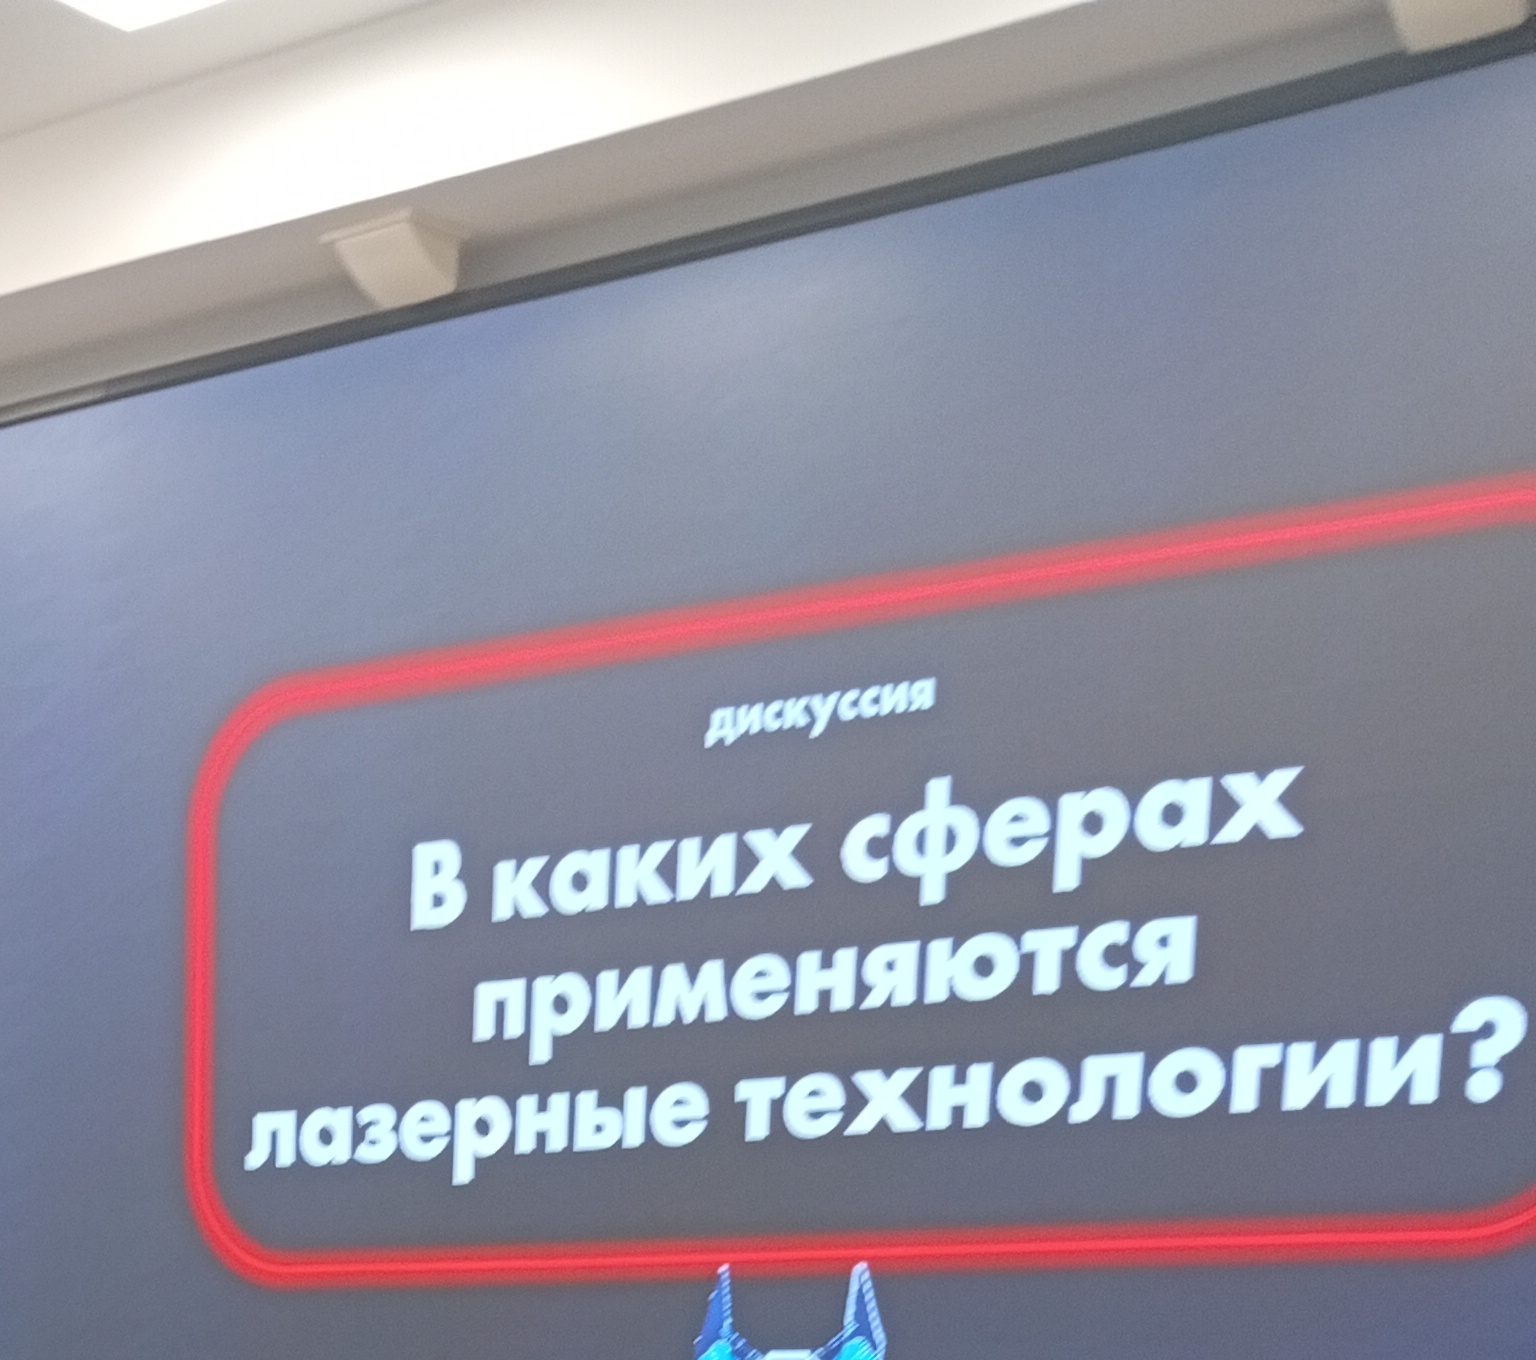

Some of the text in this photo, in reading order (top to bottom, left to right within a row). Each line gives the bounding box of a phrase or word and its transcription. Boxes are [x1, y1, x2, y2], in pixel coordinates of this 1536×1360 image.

[703, 676, 938, 750] дискуссия
[410, 764, 1305, 931] В каких сферах
[471, 914, 1198, 1066] применяются
[243, 994, 1529, 1187] лазерные технологии?
